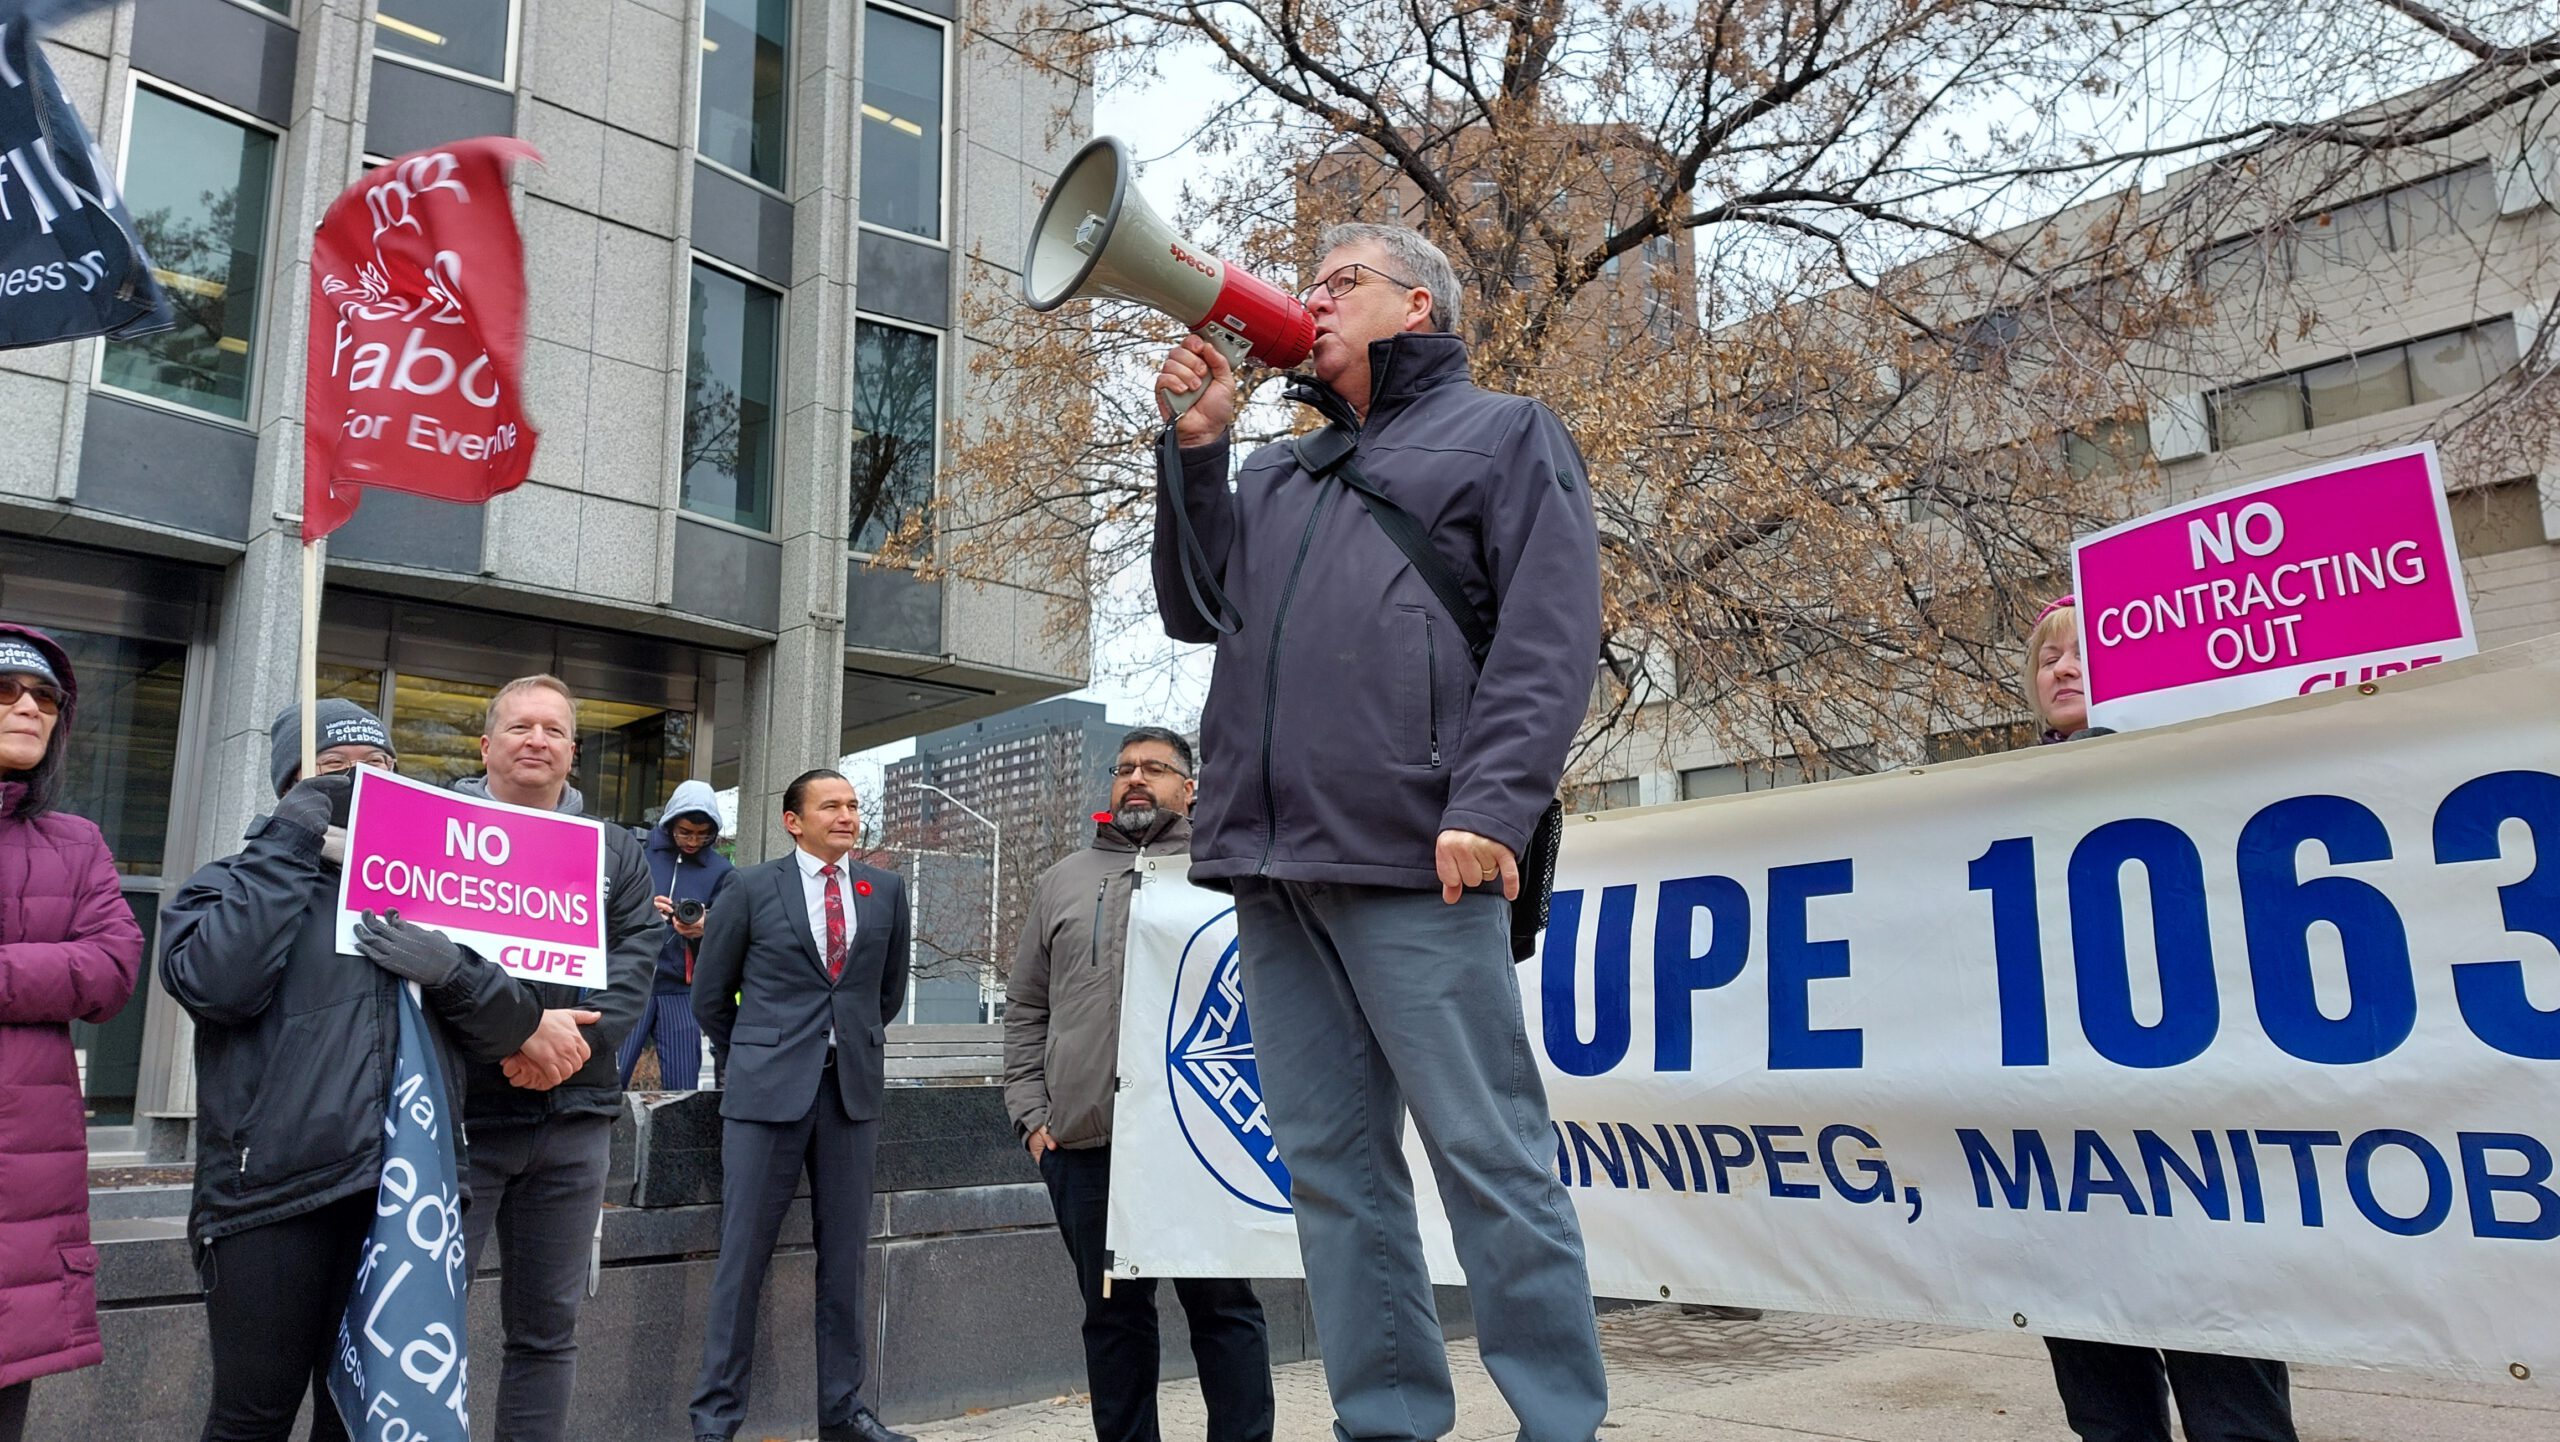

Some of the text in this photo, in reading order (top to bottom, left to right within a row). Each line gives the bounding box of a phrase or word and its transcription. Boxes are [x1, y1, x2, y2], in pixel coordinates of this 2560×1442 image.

[1170, 242, 1216, 278] speco
[2187, 501, 2285, 571] NO
[2098, 540, 2427, 648] CONTRACTING
[2207, 614, 2303, 670] OUT
[327, 725, 385, 739] Federation
[336, 732, 386, 745] of Labour
[445, 816, 511, 866] NO
[361, 854, 589, 926] CONCESSIONS
[1541, 769, 2560, 1077] UPE 1063
[499, 945, 587, 978] CUPE
[1550, 1120, 2560, 1241] INNIPEG, MANITOB
